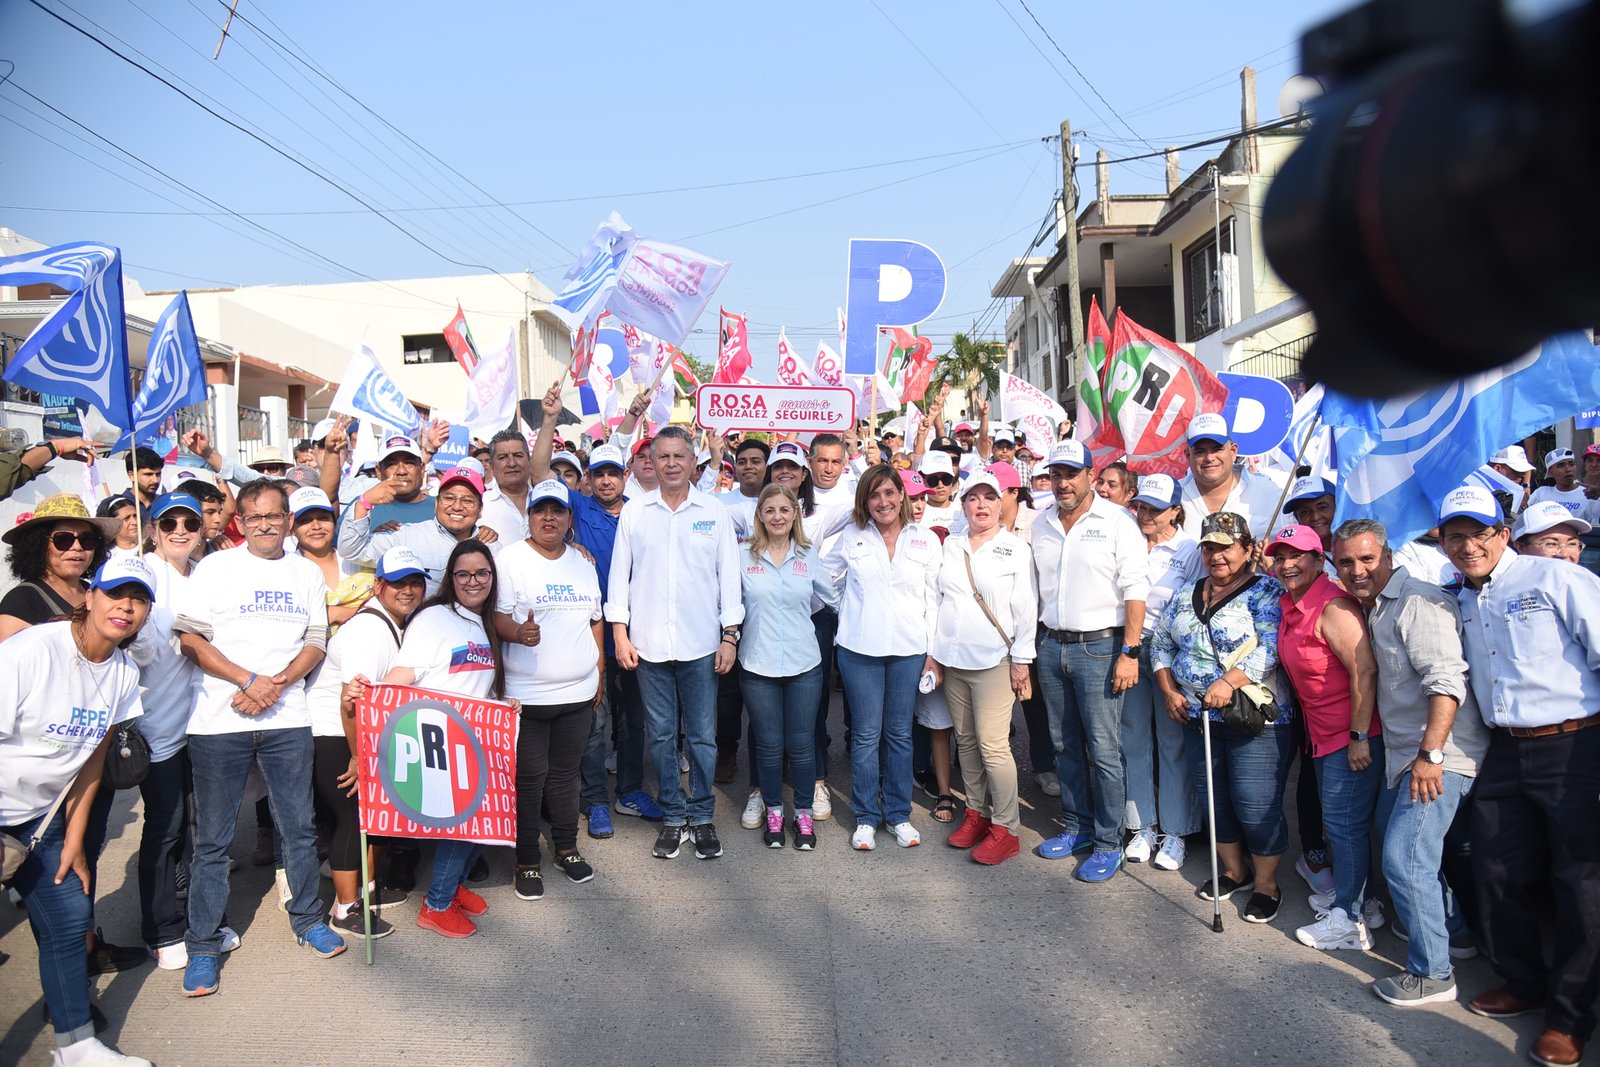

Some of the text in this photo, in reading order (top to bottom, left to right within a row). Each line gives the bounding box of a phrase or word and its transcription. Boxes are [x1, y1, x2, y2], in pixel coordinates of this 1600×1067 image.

[710, 393, 767, 410] ROSA
[1108, 360, 1186, 438] PRI
[775, 410, 834, 421] SEGUIRLE
[254, 590, 294, 605] PEPE
[545, 584, 576, 596] PEPE
[70, 707, 107, 728] PEPE
[394, 723, 470, 791] PRI
